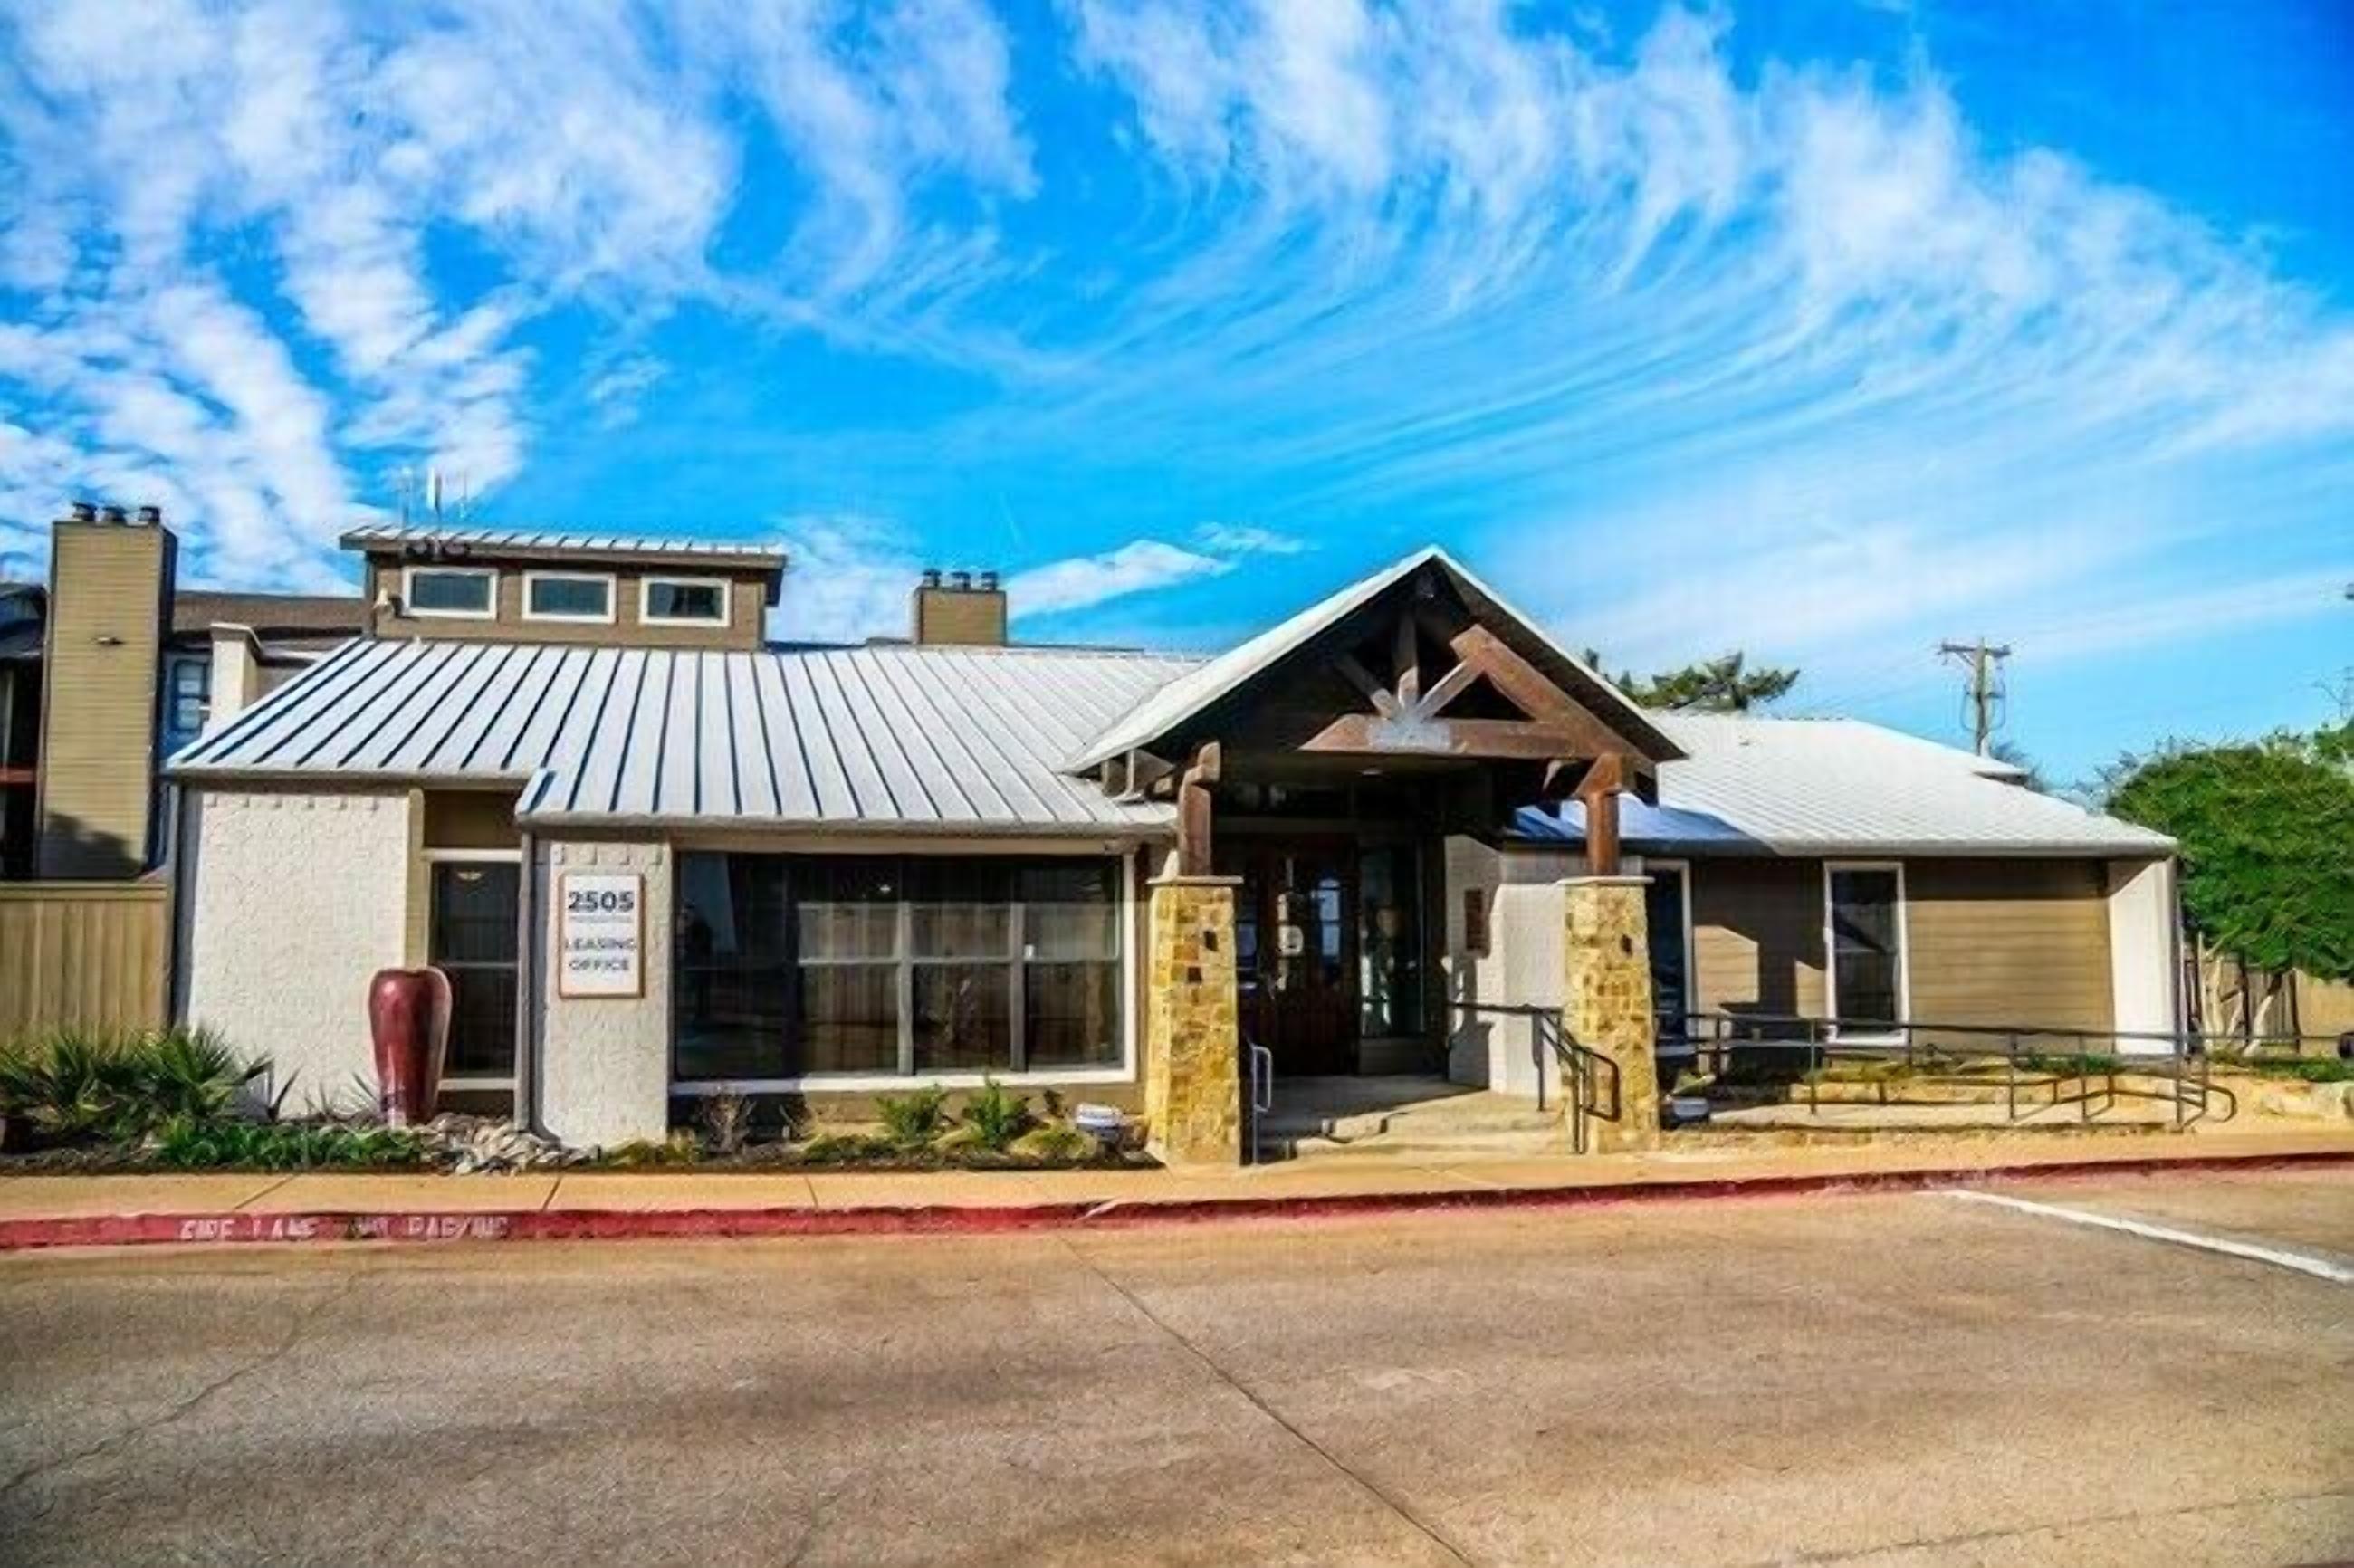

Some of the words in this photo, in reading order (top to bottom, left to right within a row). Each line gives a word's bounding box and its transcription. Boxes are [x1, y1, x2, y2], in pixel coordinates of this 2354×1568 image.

[568, 890, 634, 913] 2505
[564, 937, 637, 951] LEASING
[568, 958, 630, 971] OFFICE
